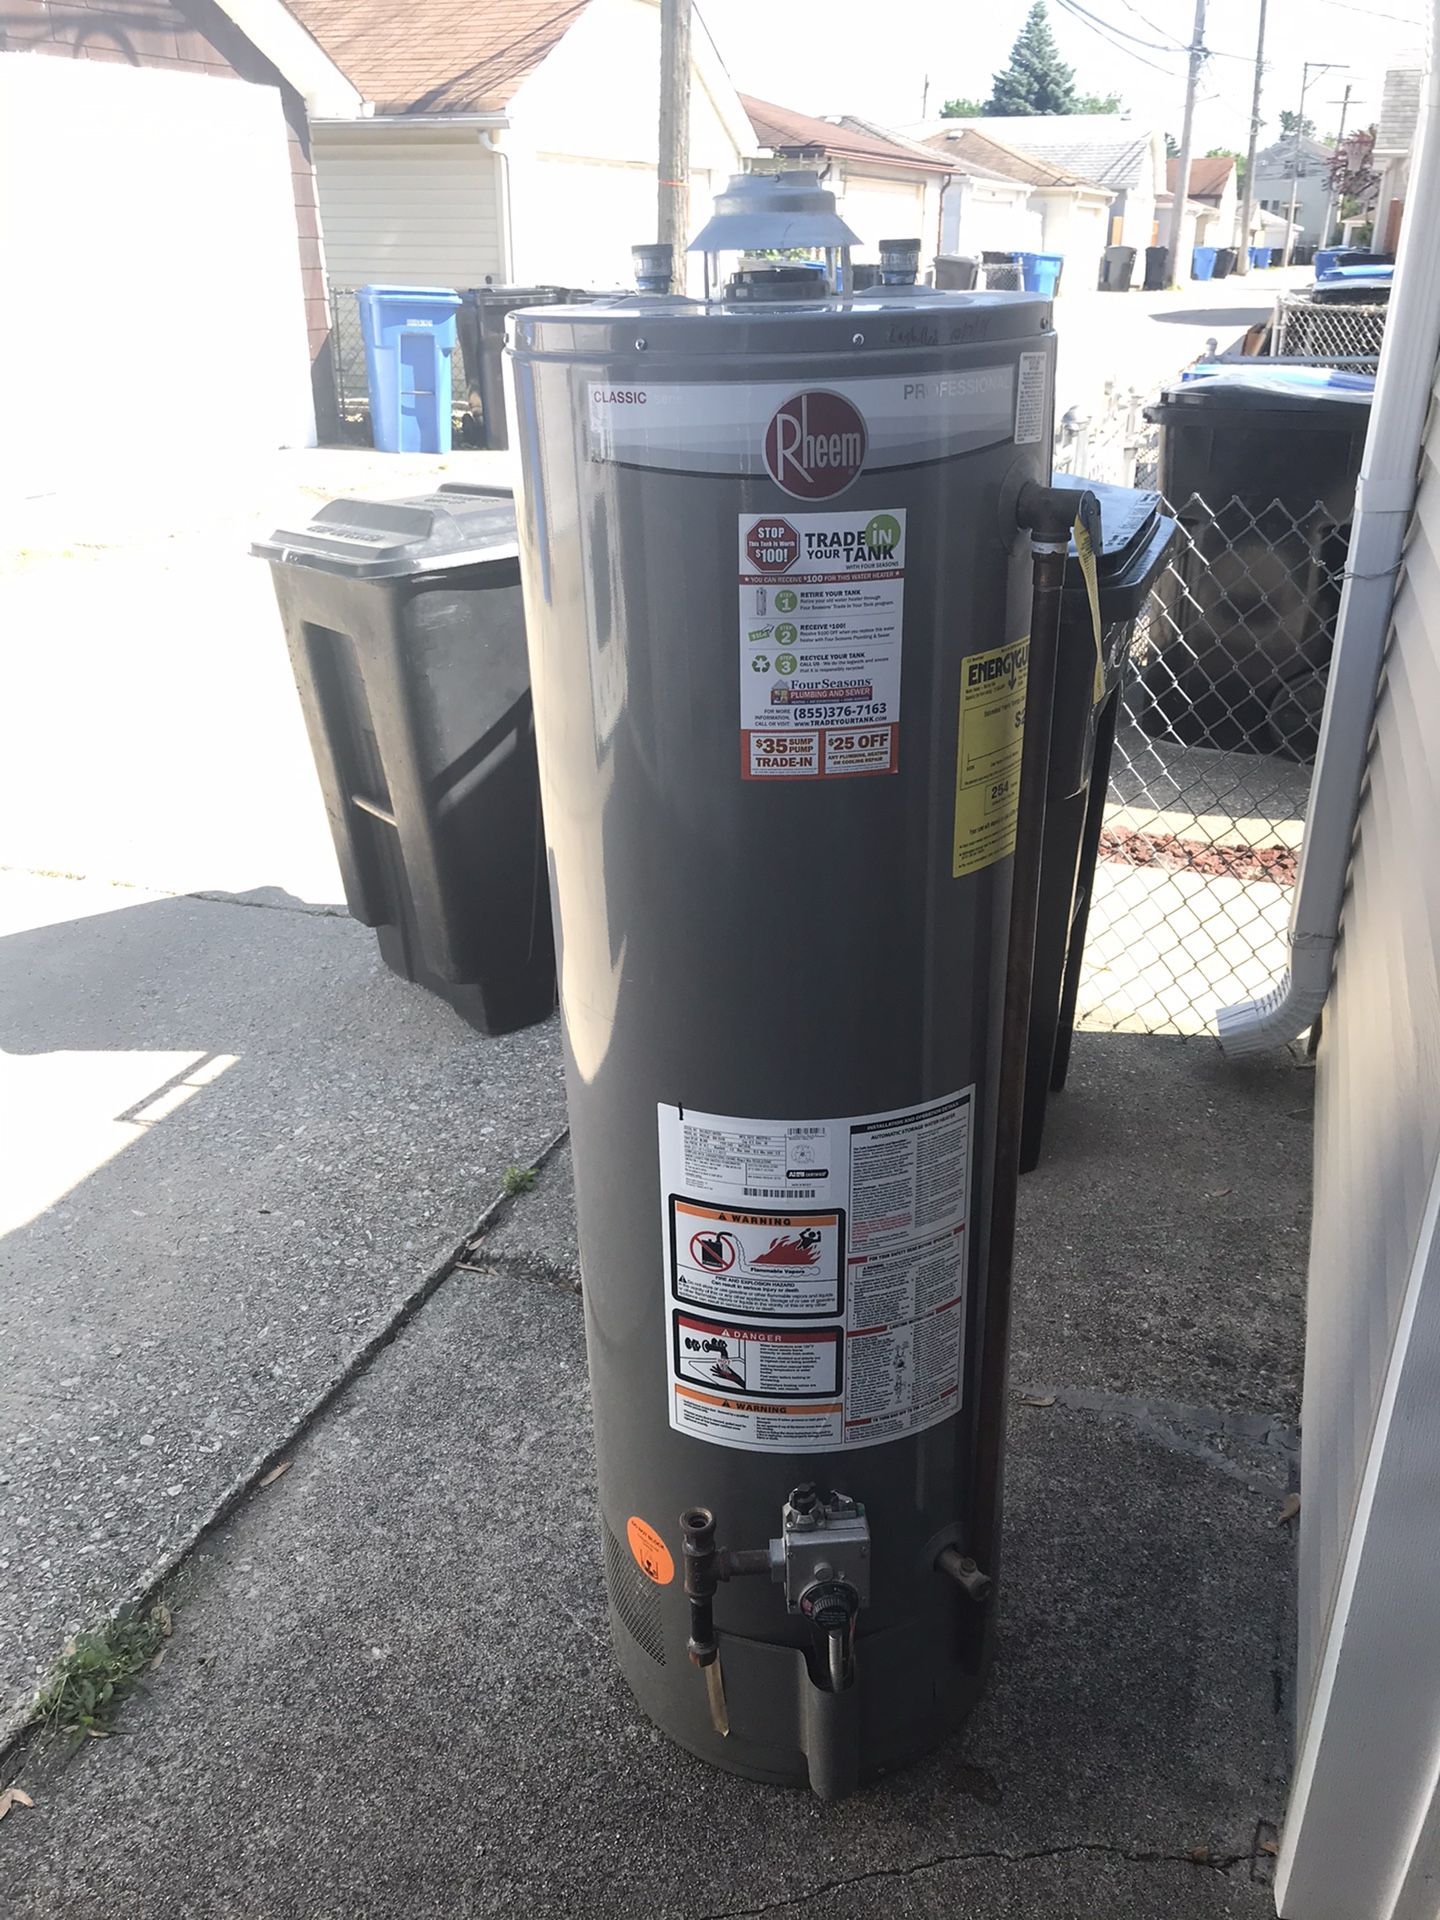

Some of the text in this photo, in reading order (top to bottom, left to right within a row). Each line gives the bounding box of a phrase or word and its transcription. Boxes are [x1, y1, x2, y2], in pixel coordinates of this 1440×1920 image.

[904, 376, 1010, 400] PRFESSIONAL
[594, 391, 647, 404] CLASSIC
[777, 395, 860, 482] Rheem
[758, 527, 785, 538] STOP
[805, 530, 866, 548] TRADE
[756, 549, 788, 563] $100!
[807, 545, 894, 562] YOUR TANK
[804, 575, 823, 583] $100
[872, 571, 894, 579] HEATER
[782, 598, 791, 611] 1
[781, 631, 792, 644] 2
[781, 661, 791, 673] 3
[968, 645, 1029, 690] ENERGYGU
[791, 687, 871, 699] PLUMBING AND SEWER
[793, 703, 887, 721] (855)376-7163
[756, 738, 788, 754] $35
[828, 733, 889, 751] $25 OFF
[755, 757, 813, 767] TRADE-IN
[991, 780, 1009, 800] 254
[732, 1214, 791, 1226] WARNING
[740, 1279, 771, 1287] EXPLOSION
[733, 1331, 782, 1342] DANGER
[736, 1402, 787, 1414] WARNING
